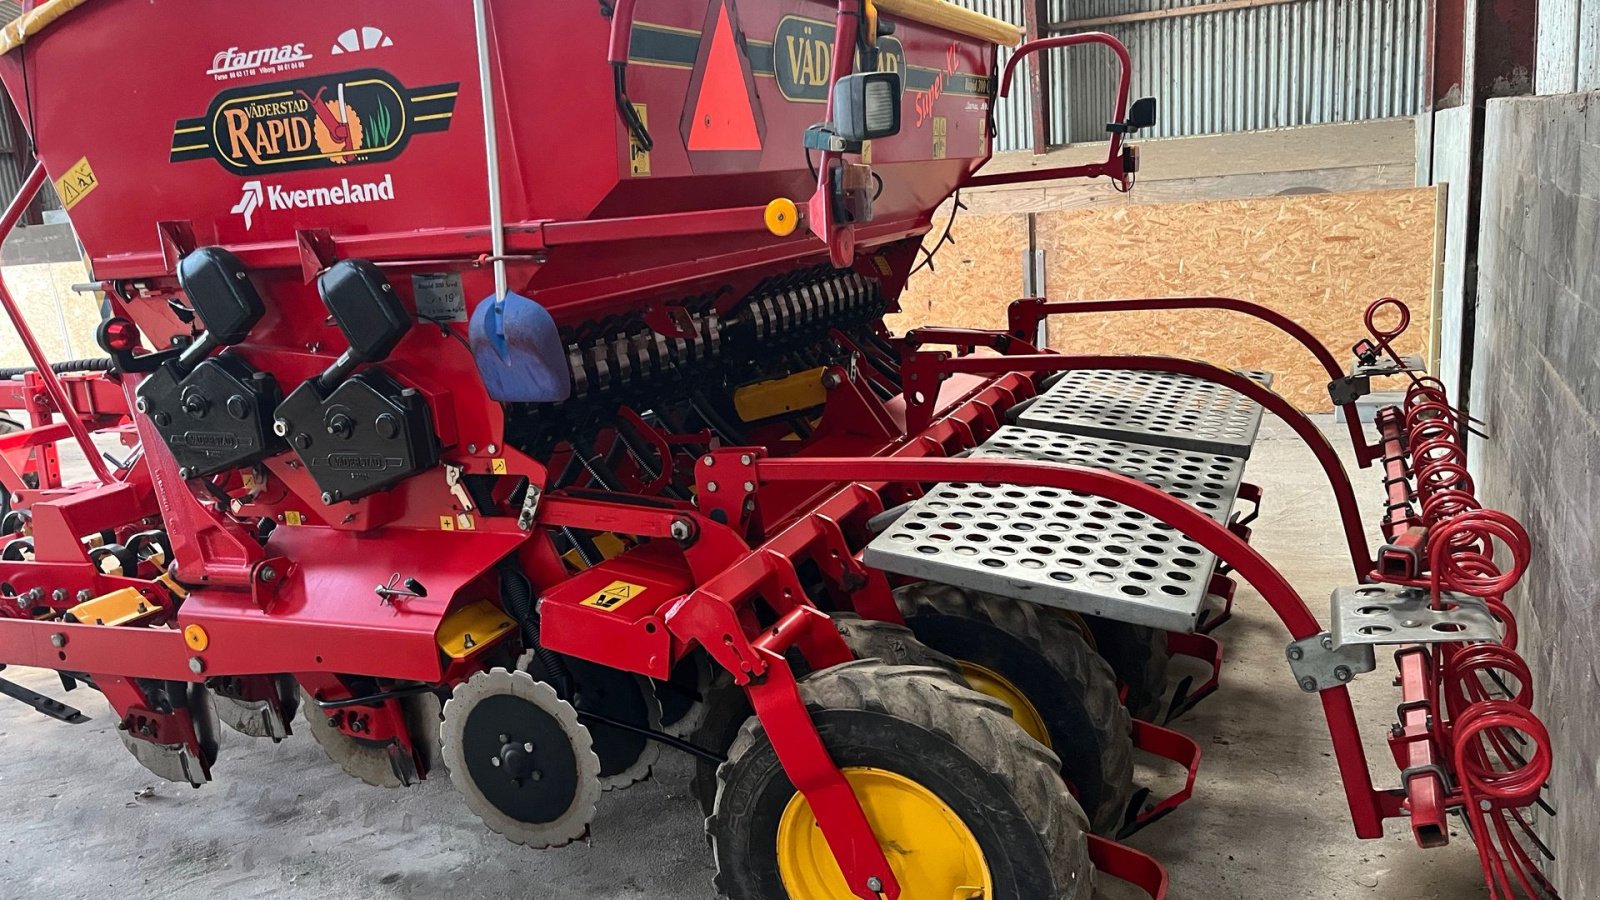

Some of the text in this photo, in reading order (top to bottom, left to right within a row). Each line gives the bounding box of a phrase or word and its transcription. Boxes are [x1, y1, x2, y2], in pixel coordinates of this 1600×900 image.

[244, 99, 309, 119] VÄDERSTAD
[915, 69, 944, 128] Super
[223, 108, 312, 165] RAPID
[266, 173, 395, 211] Kverneland
